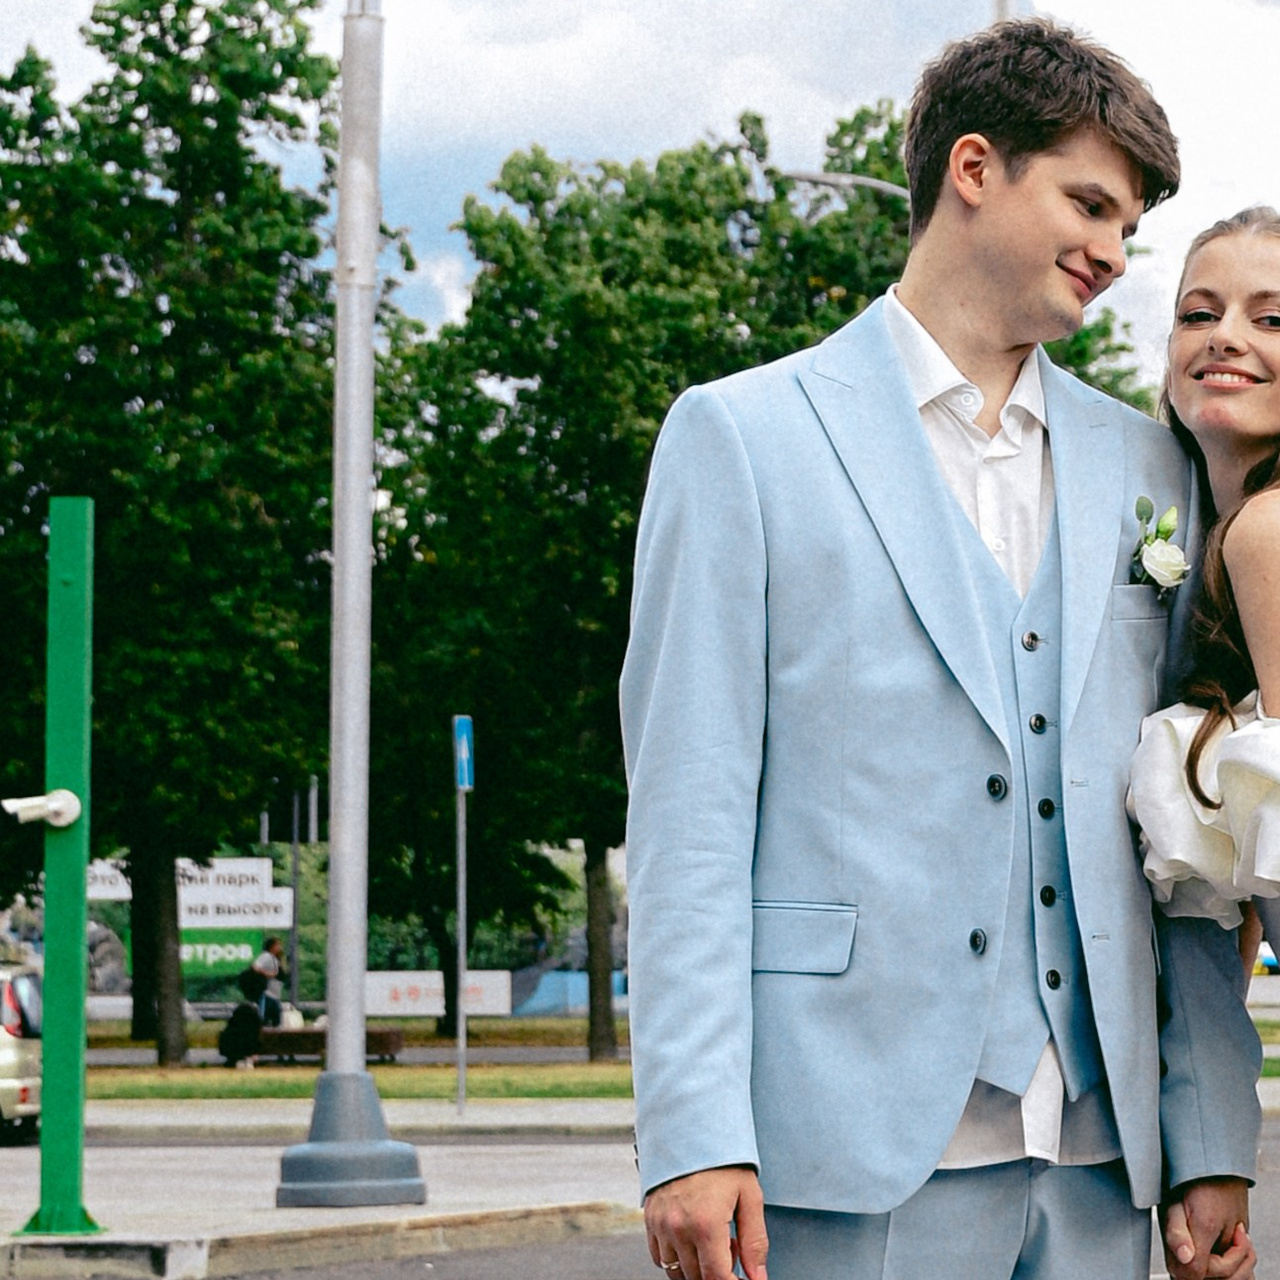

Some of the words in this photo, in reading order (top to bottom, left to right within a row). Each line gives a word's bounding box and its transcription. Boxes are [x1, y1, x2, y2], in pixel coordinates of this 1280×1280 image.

[215, 872, 261, 888] парк
[187, 903, 209, 916] на
[214, 903, 284, 916] высоте
[180, 943, 254, 966] етров
